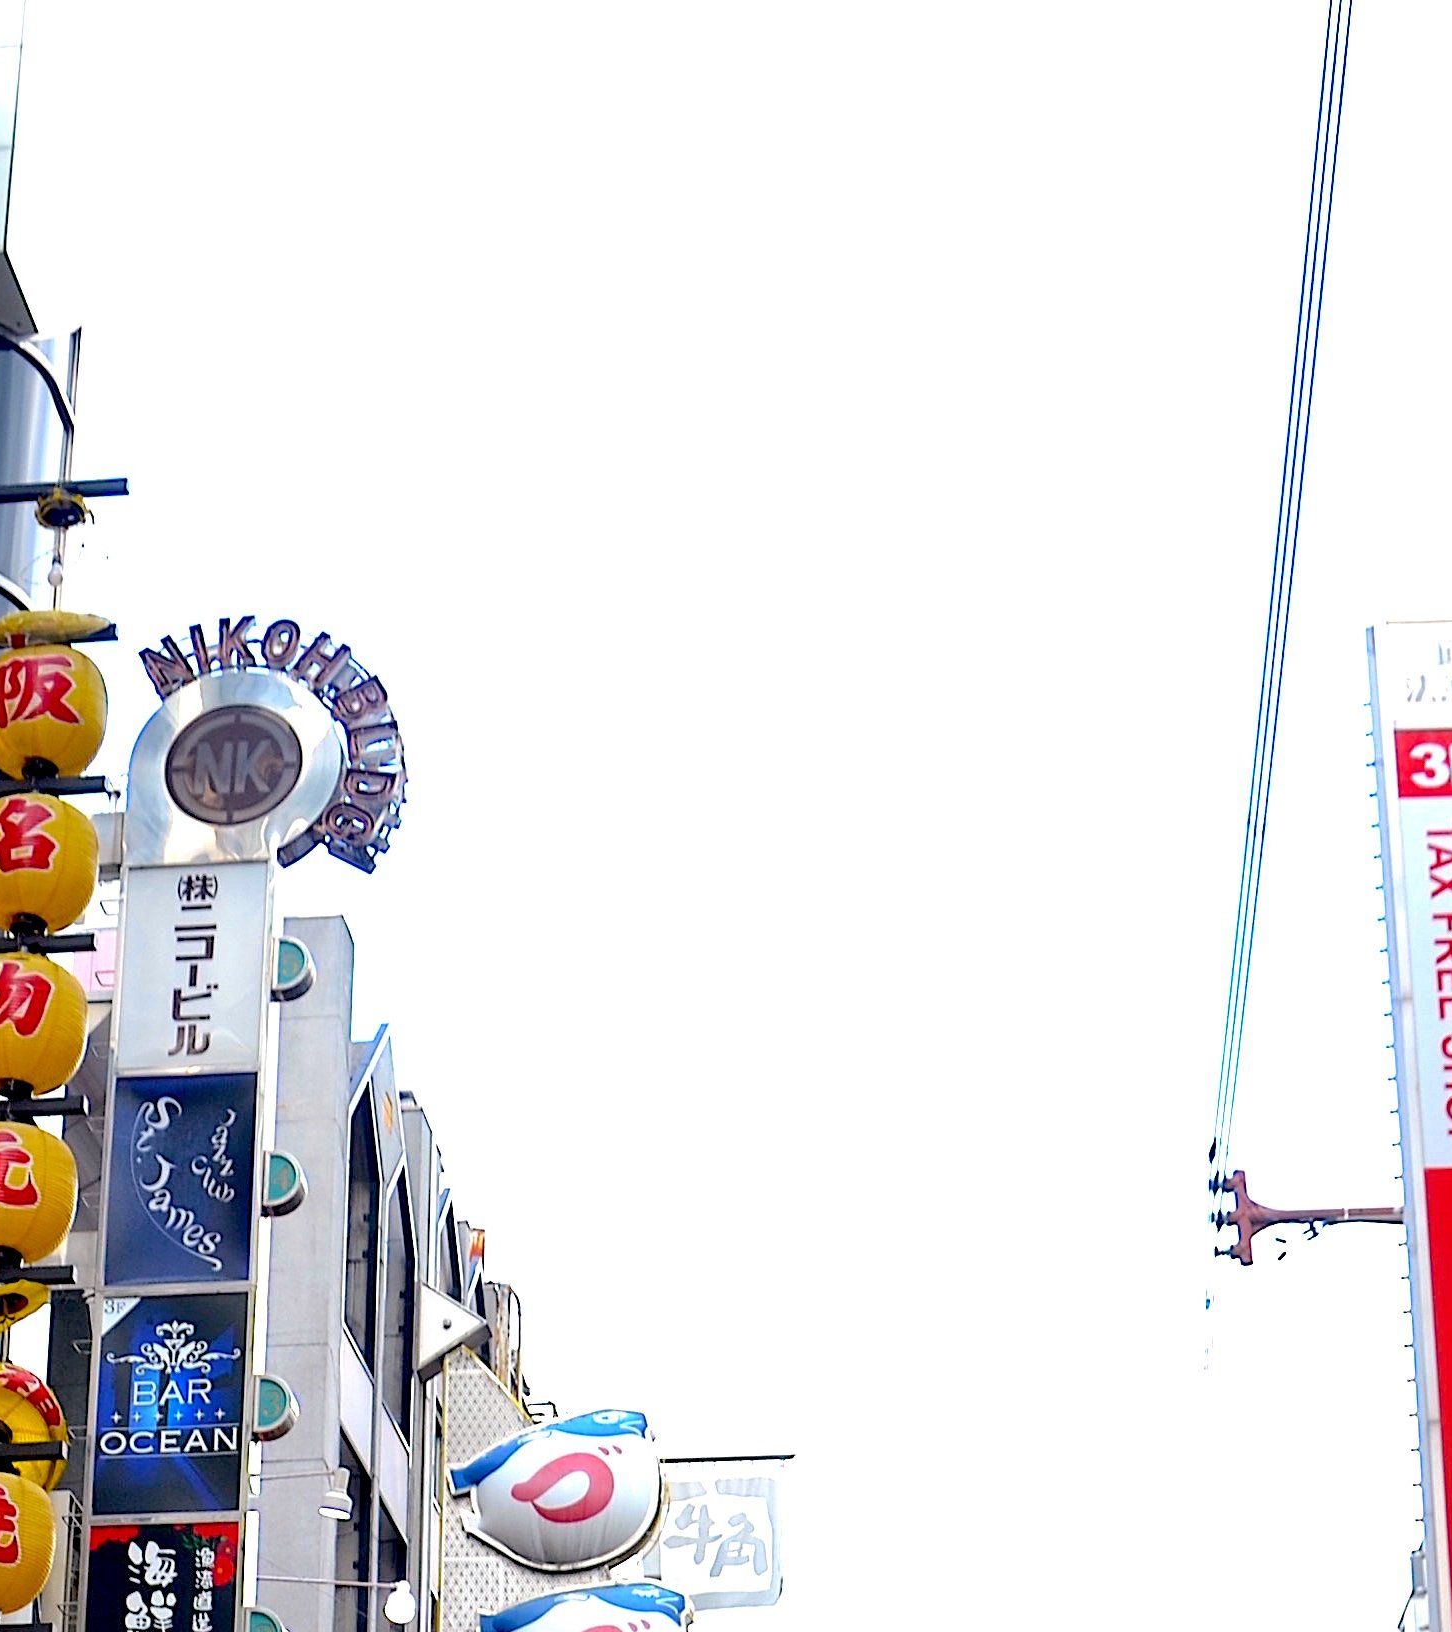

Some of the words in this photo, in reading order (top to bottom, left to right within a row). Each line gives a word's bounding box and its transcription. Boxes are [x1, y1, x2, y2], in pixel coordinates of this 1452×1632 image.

[140, 615, 350, 700] NIKOH
[195, 738, 274, 797] NK
[133, 1378, 212, 1406] BAR
[100, 1427, 238, 1455] OCEAN
